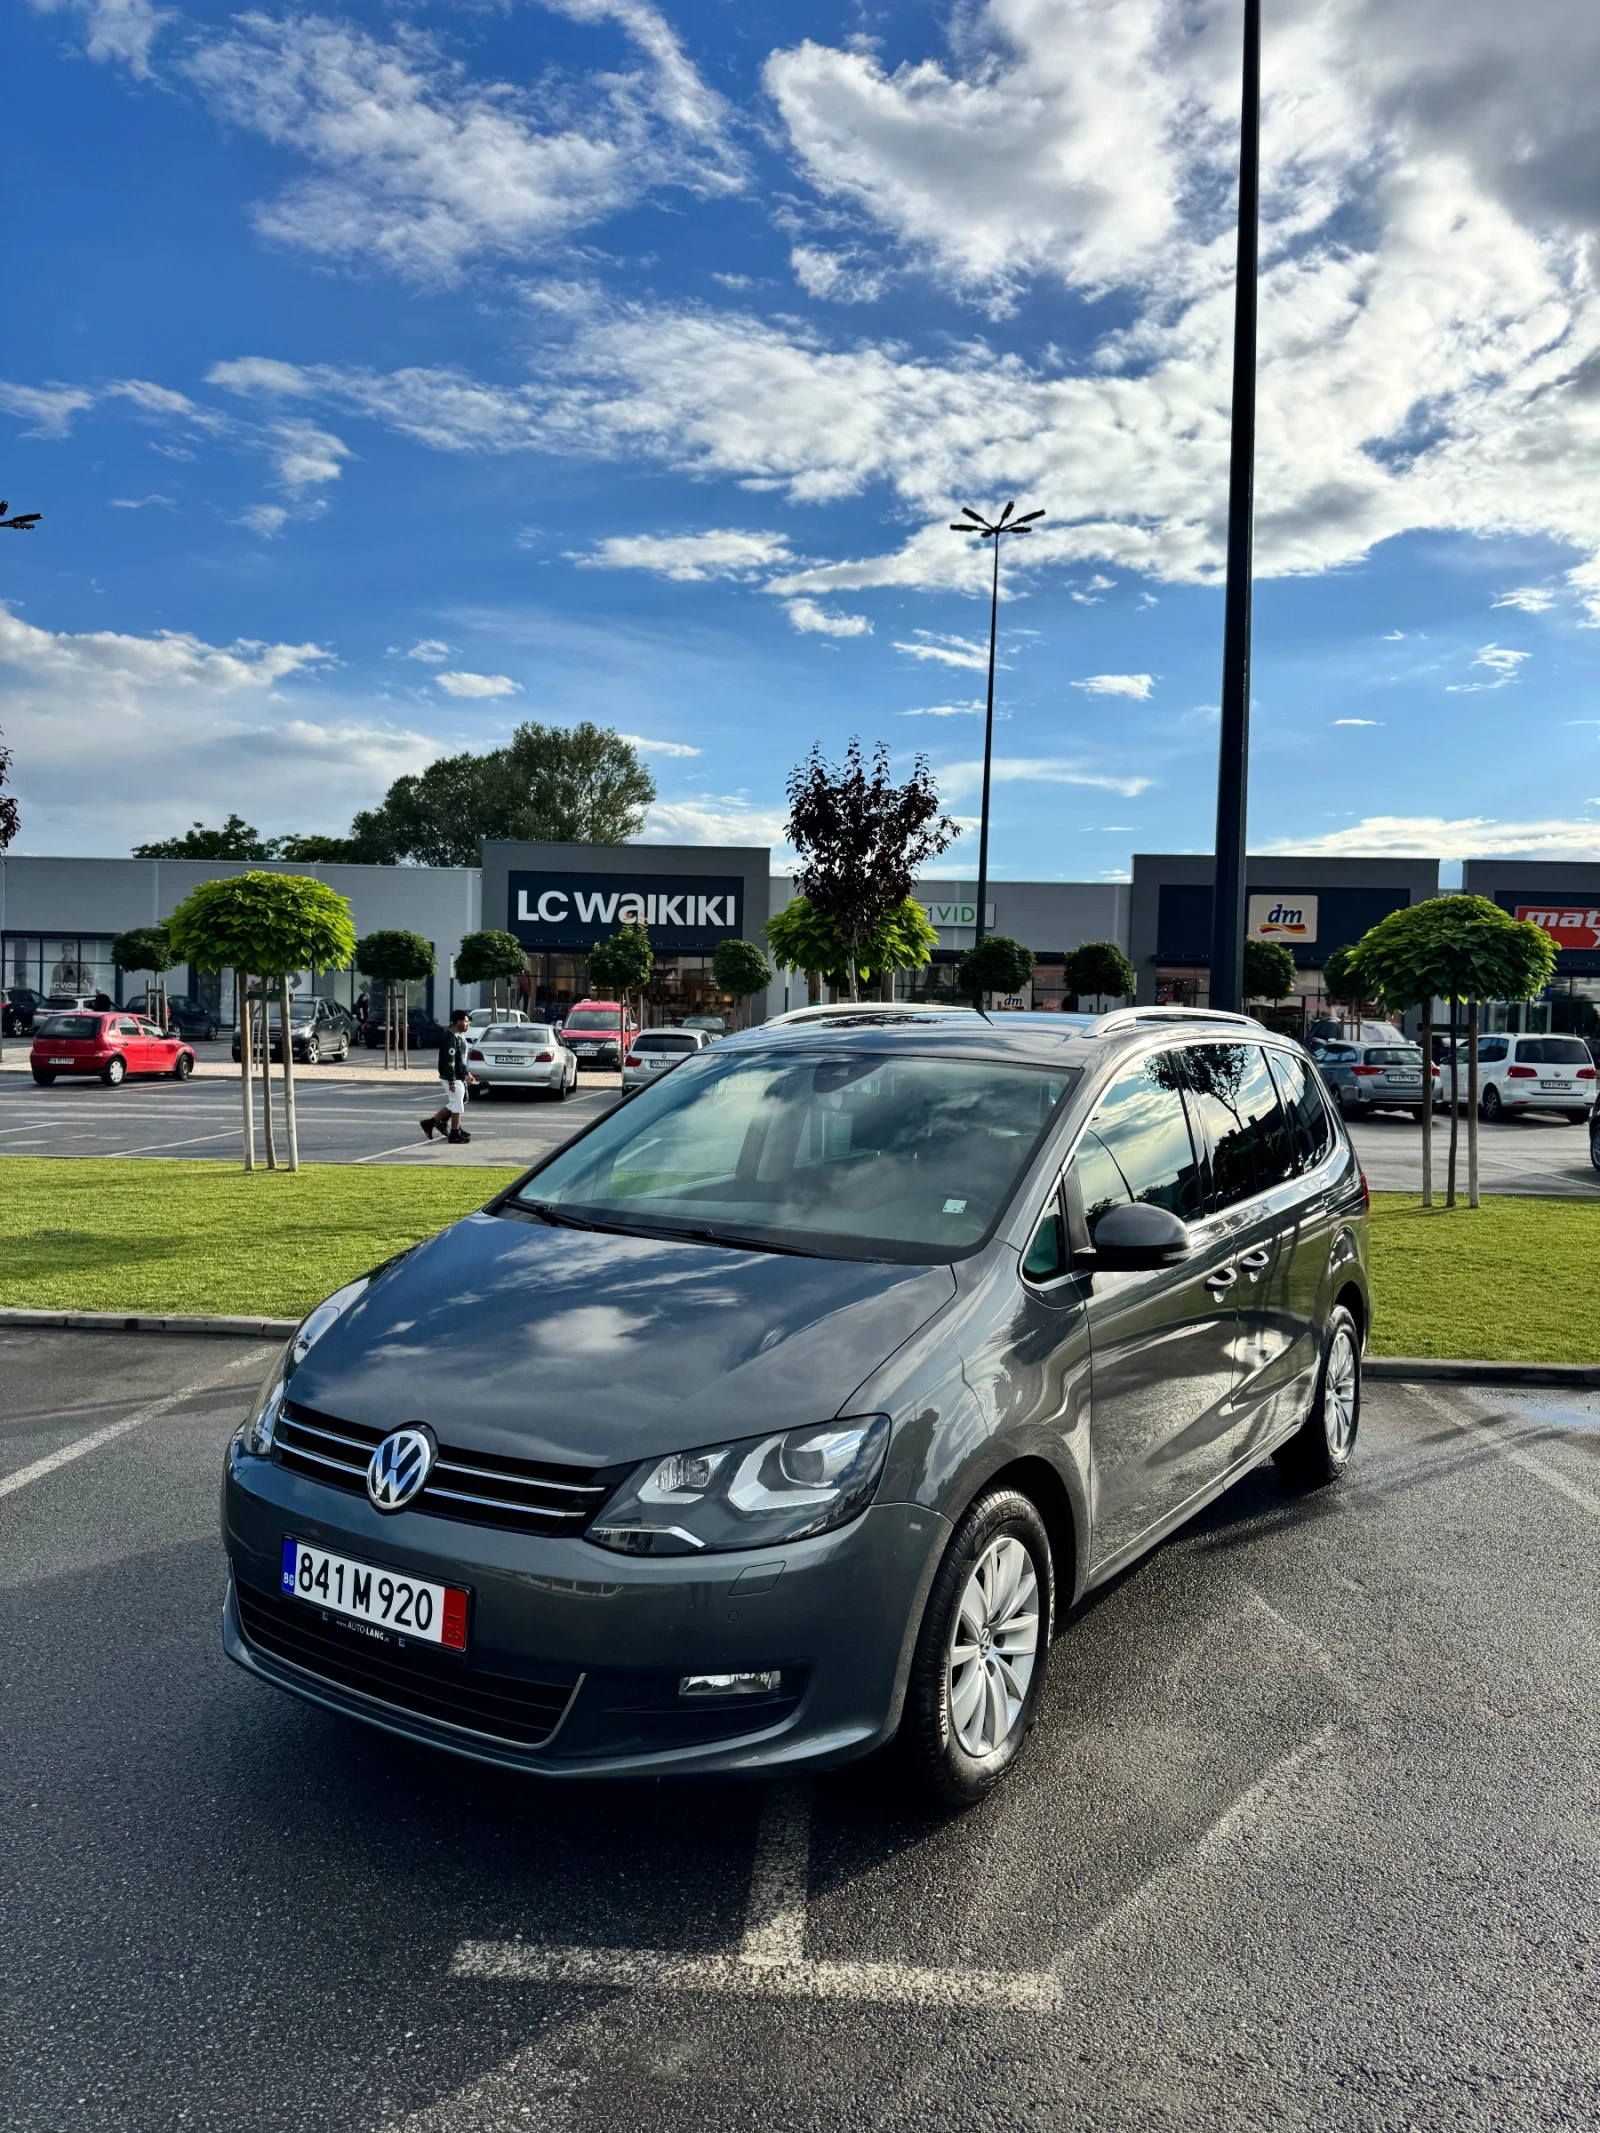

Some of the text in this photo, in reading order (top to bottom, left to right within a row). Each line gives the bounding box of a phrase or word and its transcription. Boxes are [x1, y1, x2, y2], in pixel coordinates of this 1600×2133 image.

[518, 890, 568, 922] LC
[1268, 904, 1302, 923] dm
[1004, 994, 1022, 1005] dm
[283, 1572, 294, 1586] BG
